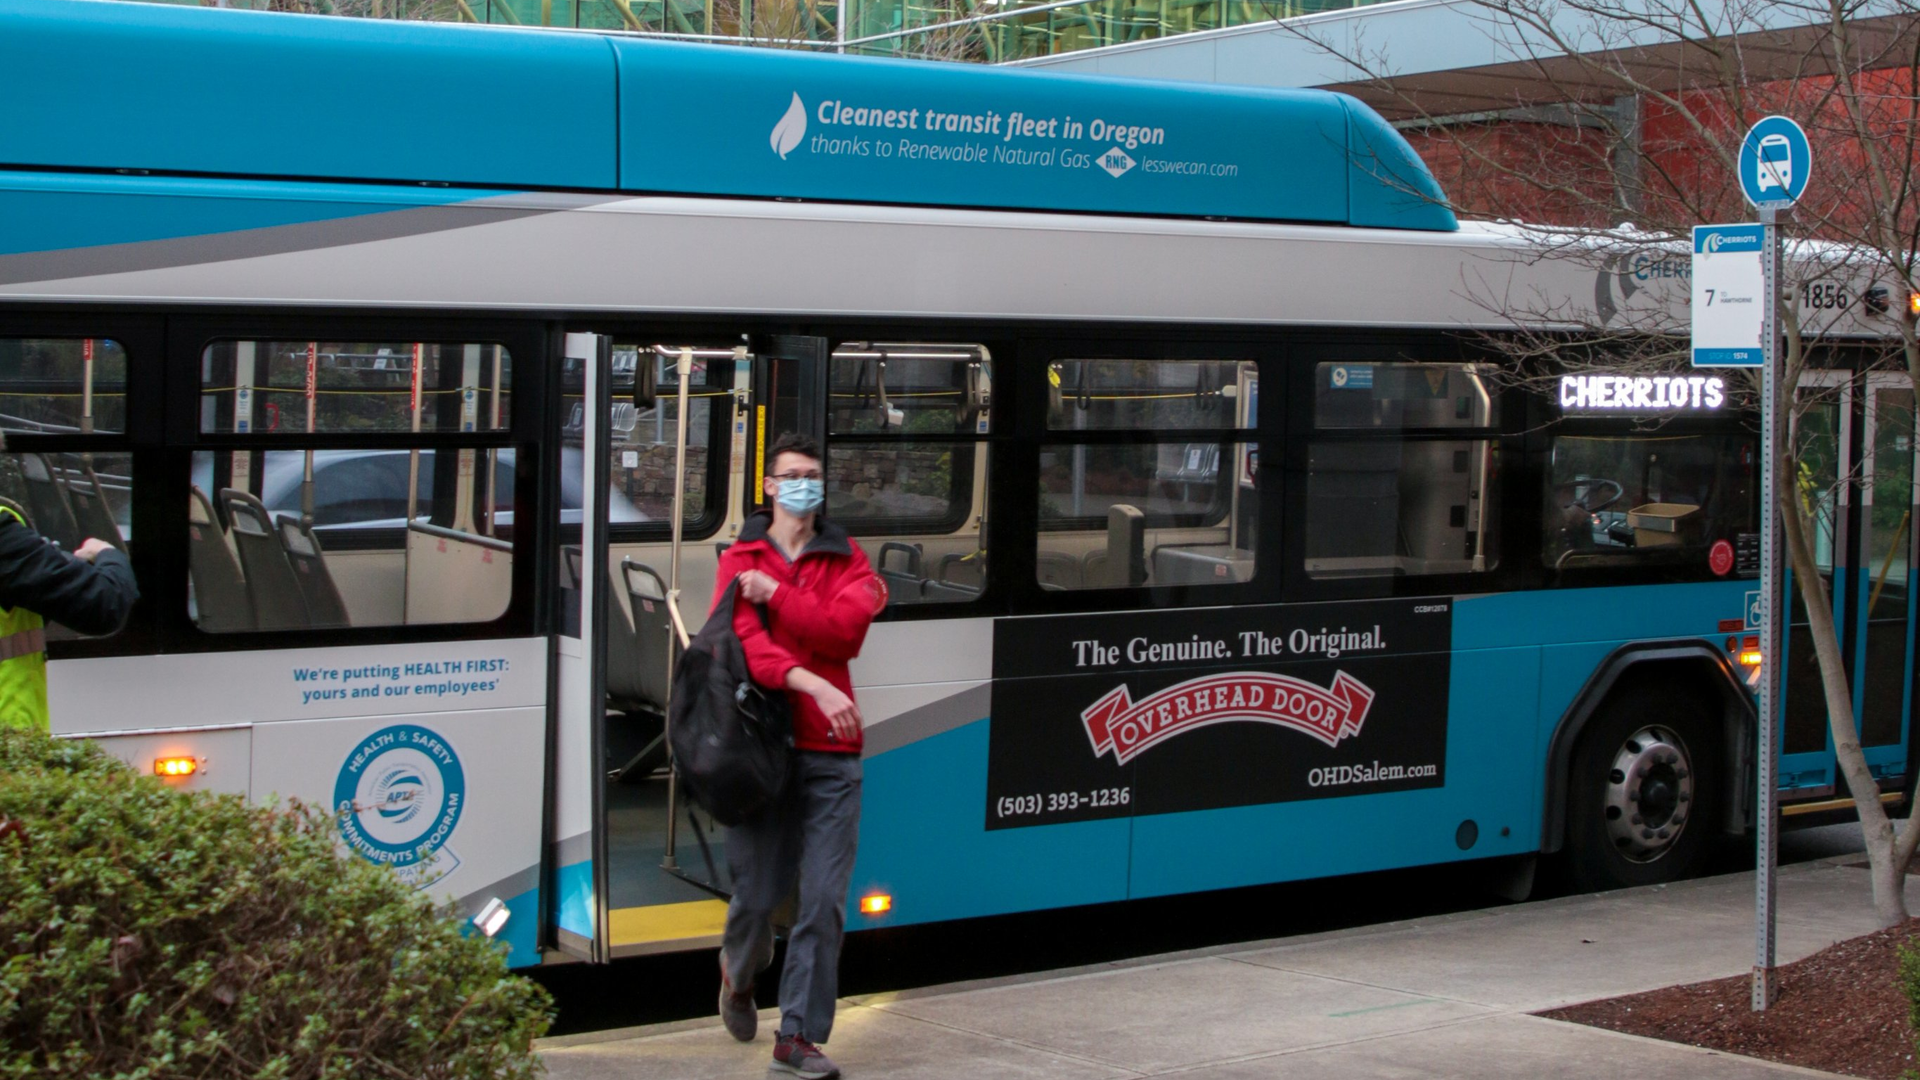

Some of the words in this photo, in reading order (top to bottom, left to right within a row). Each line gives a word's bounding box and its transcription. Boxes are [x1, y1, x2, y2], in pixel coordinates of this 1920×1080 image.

[817, 100, 919, 129] Cleanest
[925, 109, 1001, 134] transit
[1003, 112, 1058, 142] fleet
[1062, 116, 1083, 139] in
[1089, 119, 1165, 149] Oregon
[811, 133, 870, 156] thanks
[875, 139, 892, 157] to
[898, 138, 988, 163] Renewable
[992, 145, 1056, 166] Natural
[1060, 148, 1091, 169] Gas
[1105, 154, 1127, 170] RNG
[1141, 156, 1239, 177] lesswecan.com
[1716, 235, 1757, 246] CHERRIOTS
[1705, 289, 1715, 307] 7
[1804, 283, 1847, 309] 1856
[1733, 352, 1749, 360] 1574
[1560, 376, 1725, 408] CHERRIOTS
[1073, 640, 1120, 667] The
[1127, 635, 1232, 664] Genuine.
[1239, 631, 1283, 656] The
[1289, 625, 1387, 658] Original.
[293, 667, 339, 682] We're
[343, 664, 400, 683] putting
[404, 661, 462, 676] HEALTH
[466, 658, 510, 673] FIRST:
[303, 687, 347, 704] yours
[351, 684, 380, 698] and
[384, 683, 410, 697] our
[414, 678, 500, 697] employees'
[1120, 685, 1265, 745] OVERHEAD
[1272, 688, 1338, 731] DOOR
[348, 732, 395, 773] HEALTH
[398, 731, 408, 741] &
[412, 732, 453, 765] SAFETY
[1308, 760, 1437, 787] OHDSalem.com
[997, 793, 1042, 818] (503)
[1047, 787, 1130, 811] 393-1236
[340, 799, 414, 863] COMMITMENTS
[415, 793, 459, 856] PROGRAM
